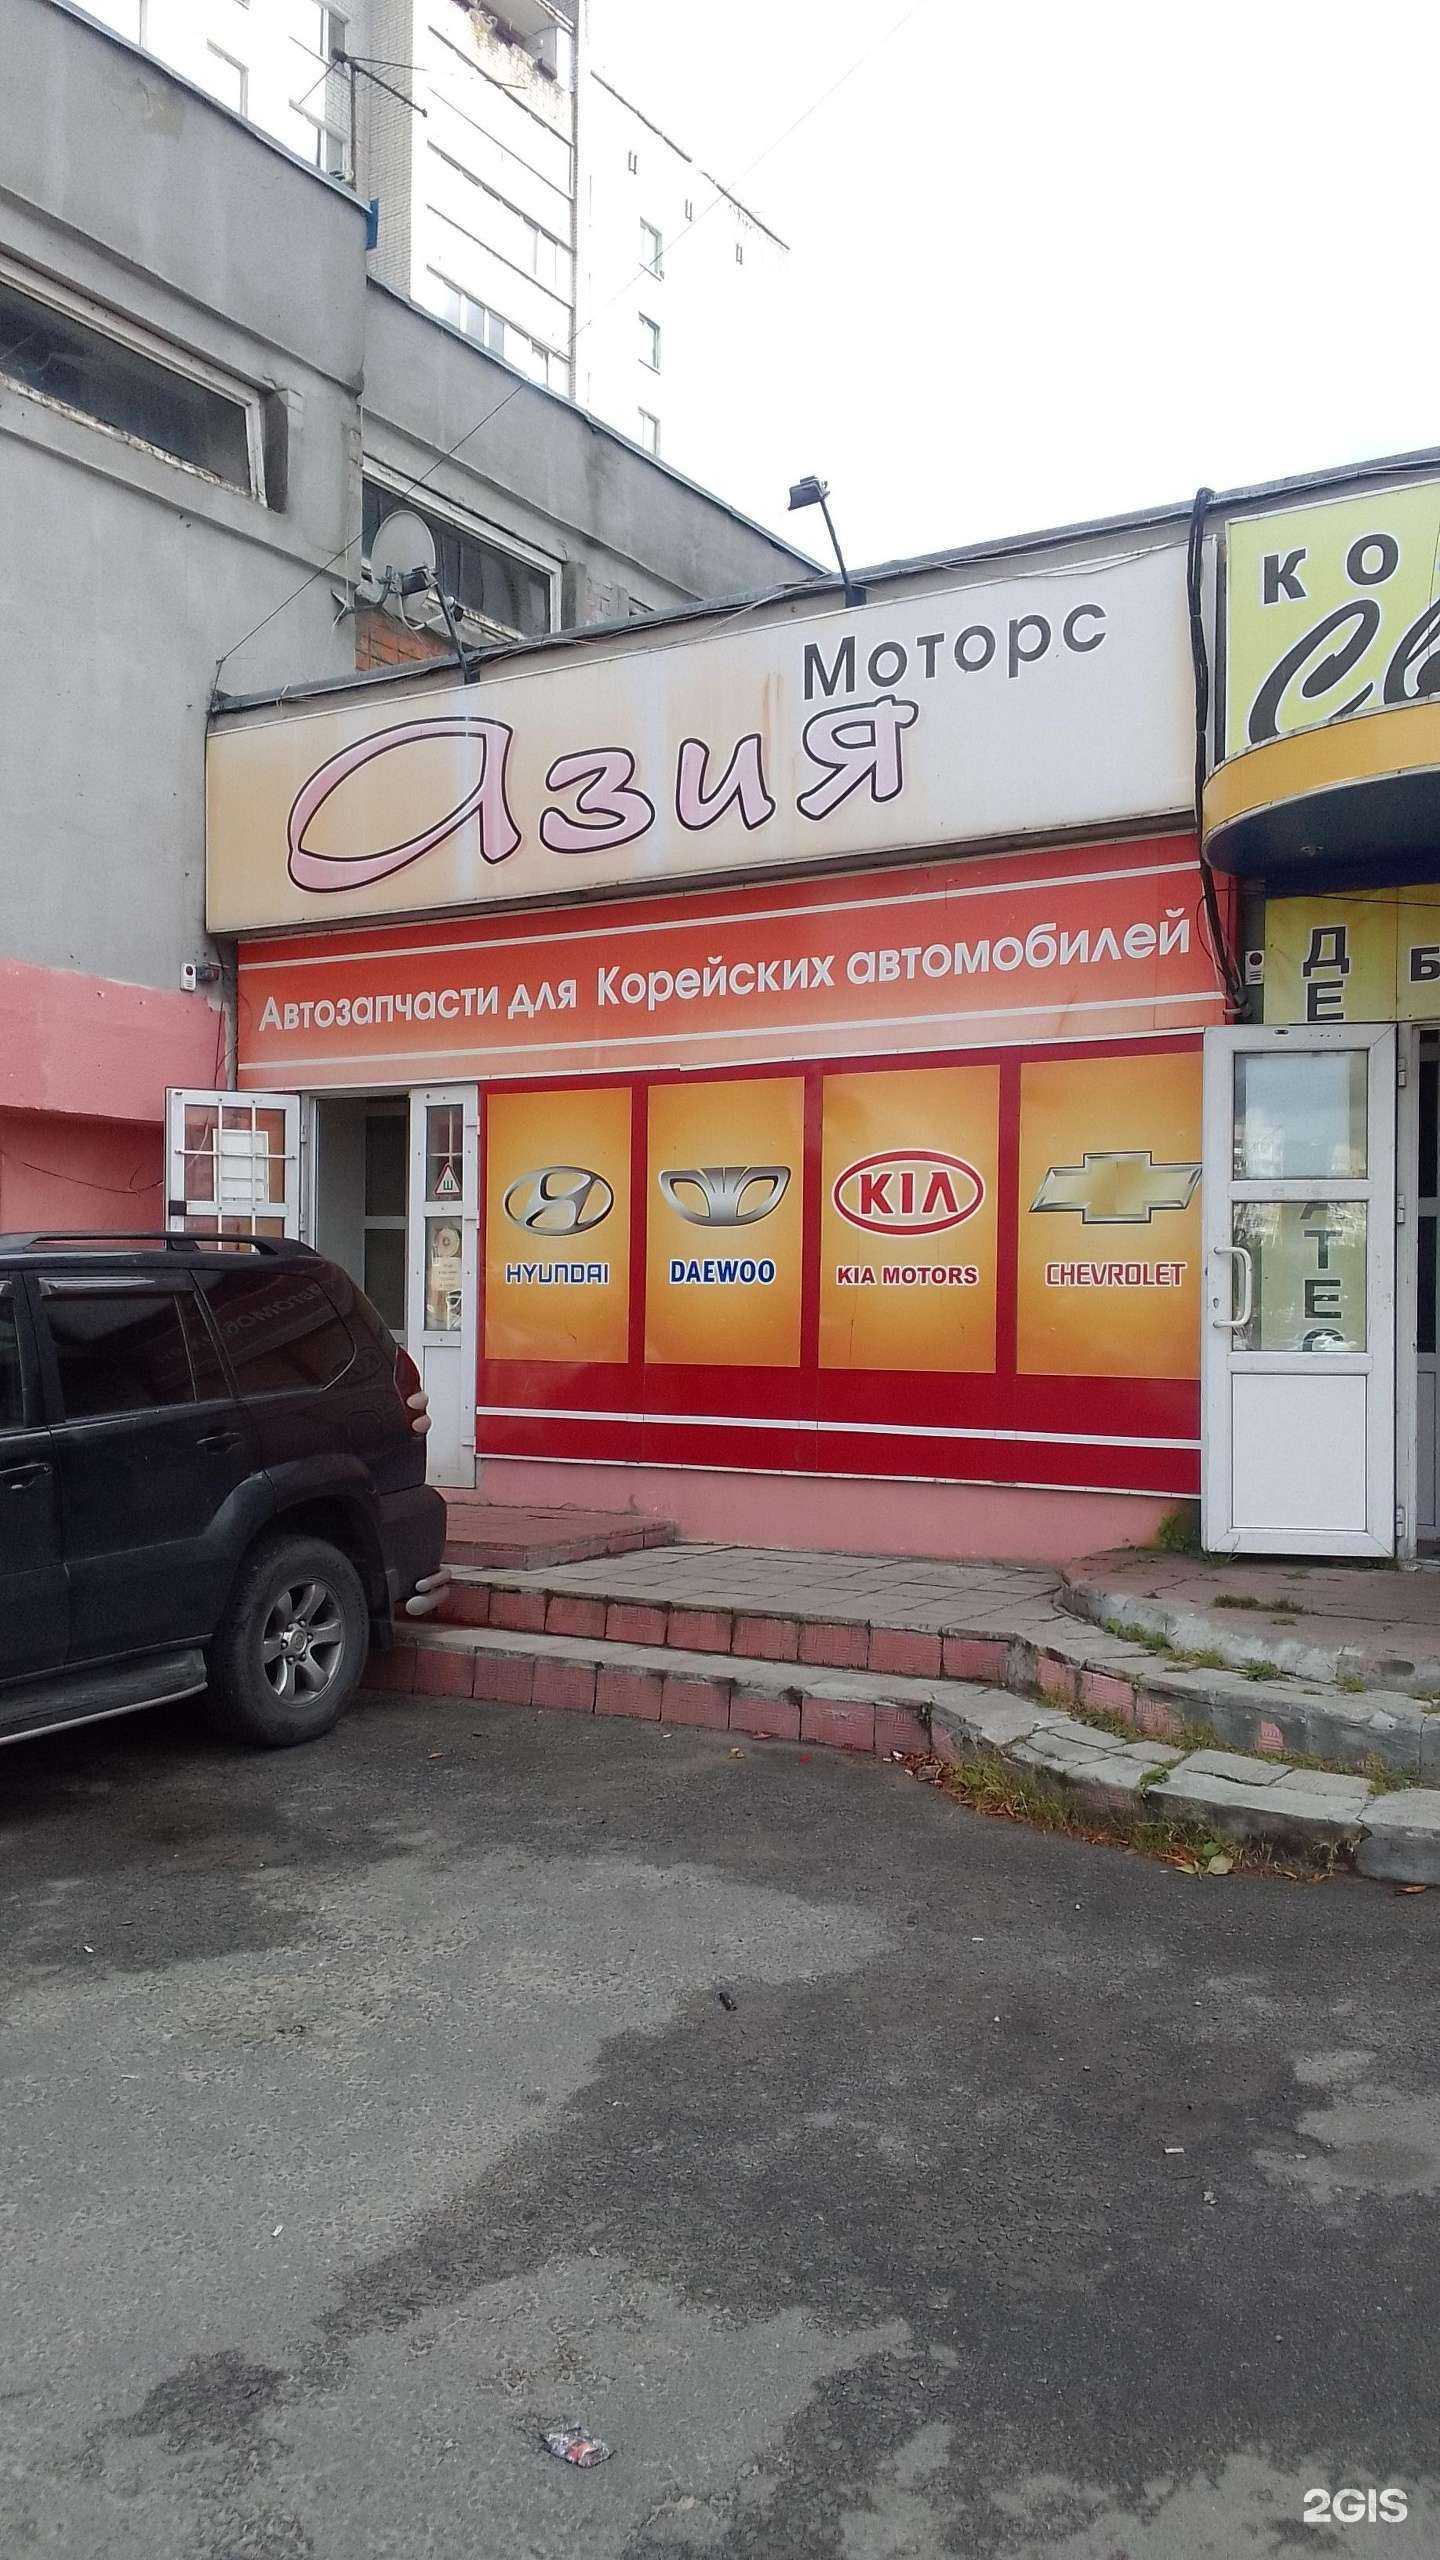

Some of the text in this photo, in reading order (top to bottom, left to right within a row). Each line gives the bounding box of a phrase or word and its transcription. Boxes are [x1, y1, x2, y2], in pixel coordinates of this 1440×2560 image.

[803, 603, 1108, 700] Моторс
[258, 908, 1191, 1032] Автозапчасти для Корейских автомобилей
[859, 1171, 960, 1215] KIA
[505, 1263, 610, 1284] HYUNDAI
[669, 1258, 776, 1284] DAEWOO
[836, 1264, 979, 1286] KIA MOTORS
[1045, 1261, 1187, 1288] CHEVROLET
